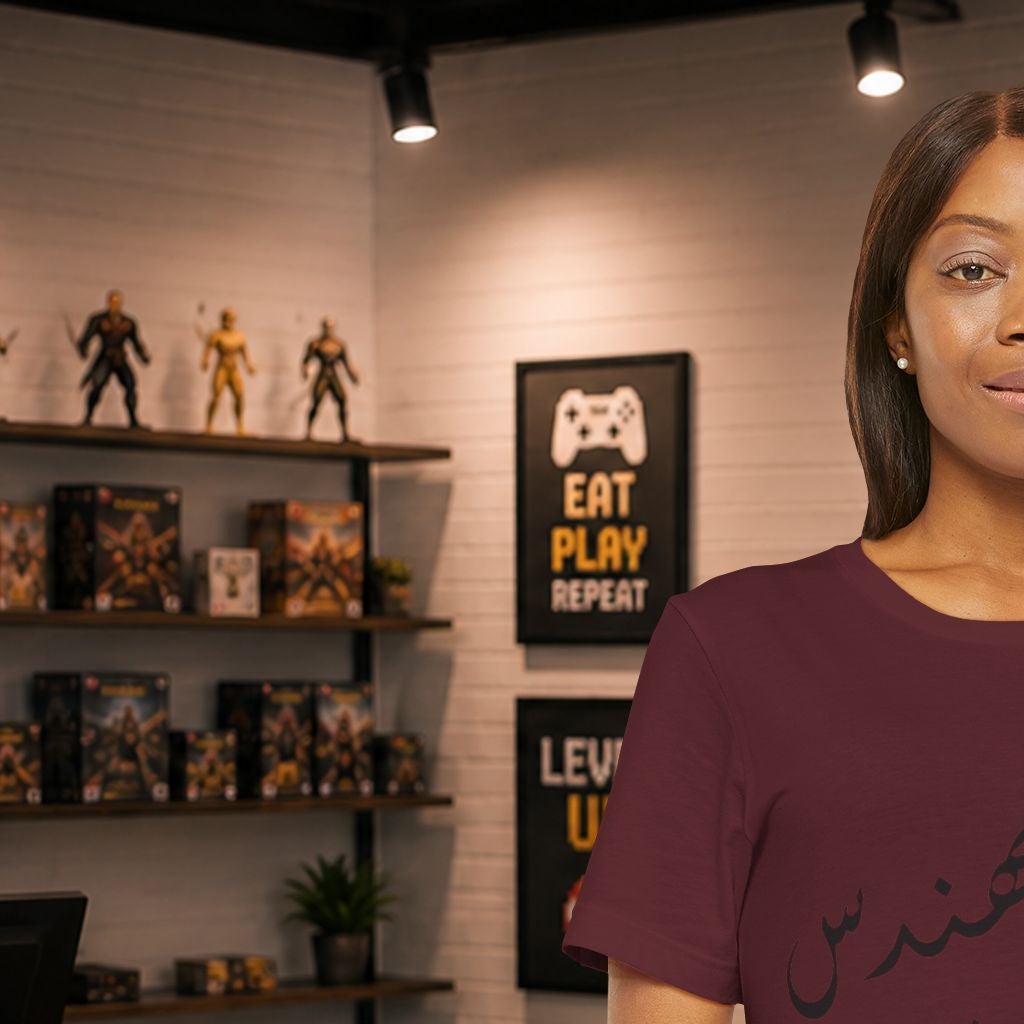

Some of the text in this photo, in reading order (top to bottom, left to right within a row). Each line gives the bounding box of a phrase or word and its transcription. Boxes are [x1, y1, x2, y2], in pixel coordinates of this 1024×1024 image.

[563, 471, 637, 519] EAT
[551, 525, 648, 573] PLAY
[550, 578, 649, 612] REPEAT
